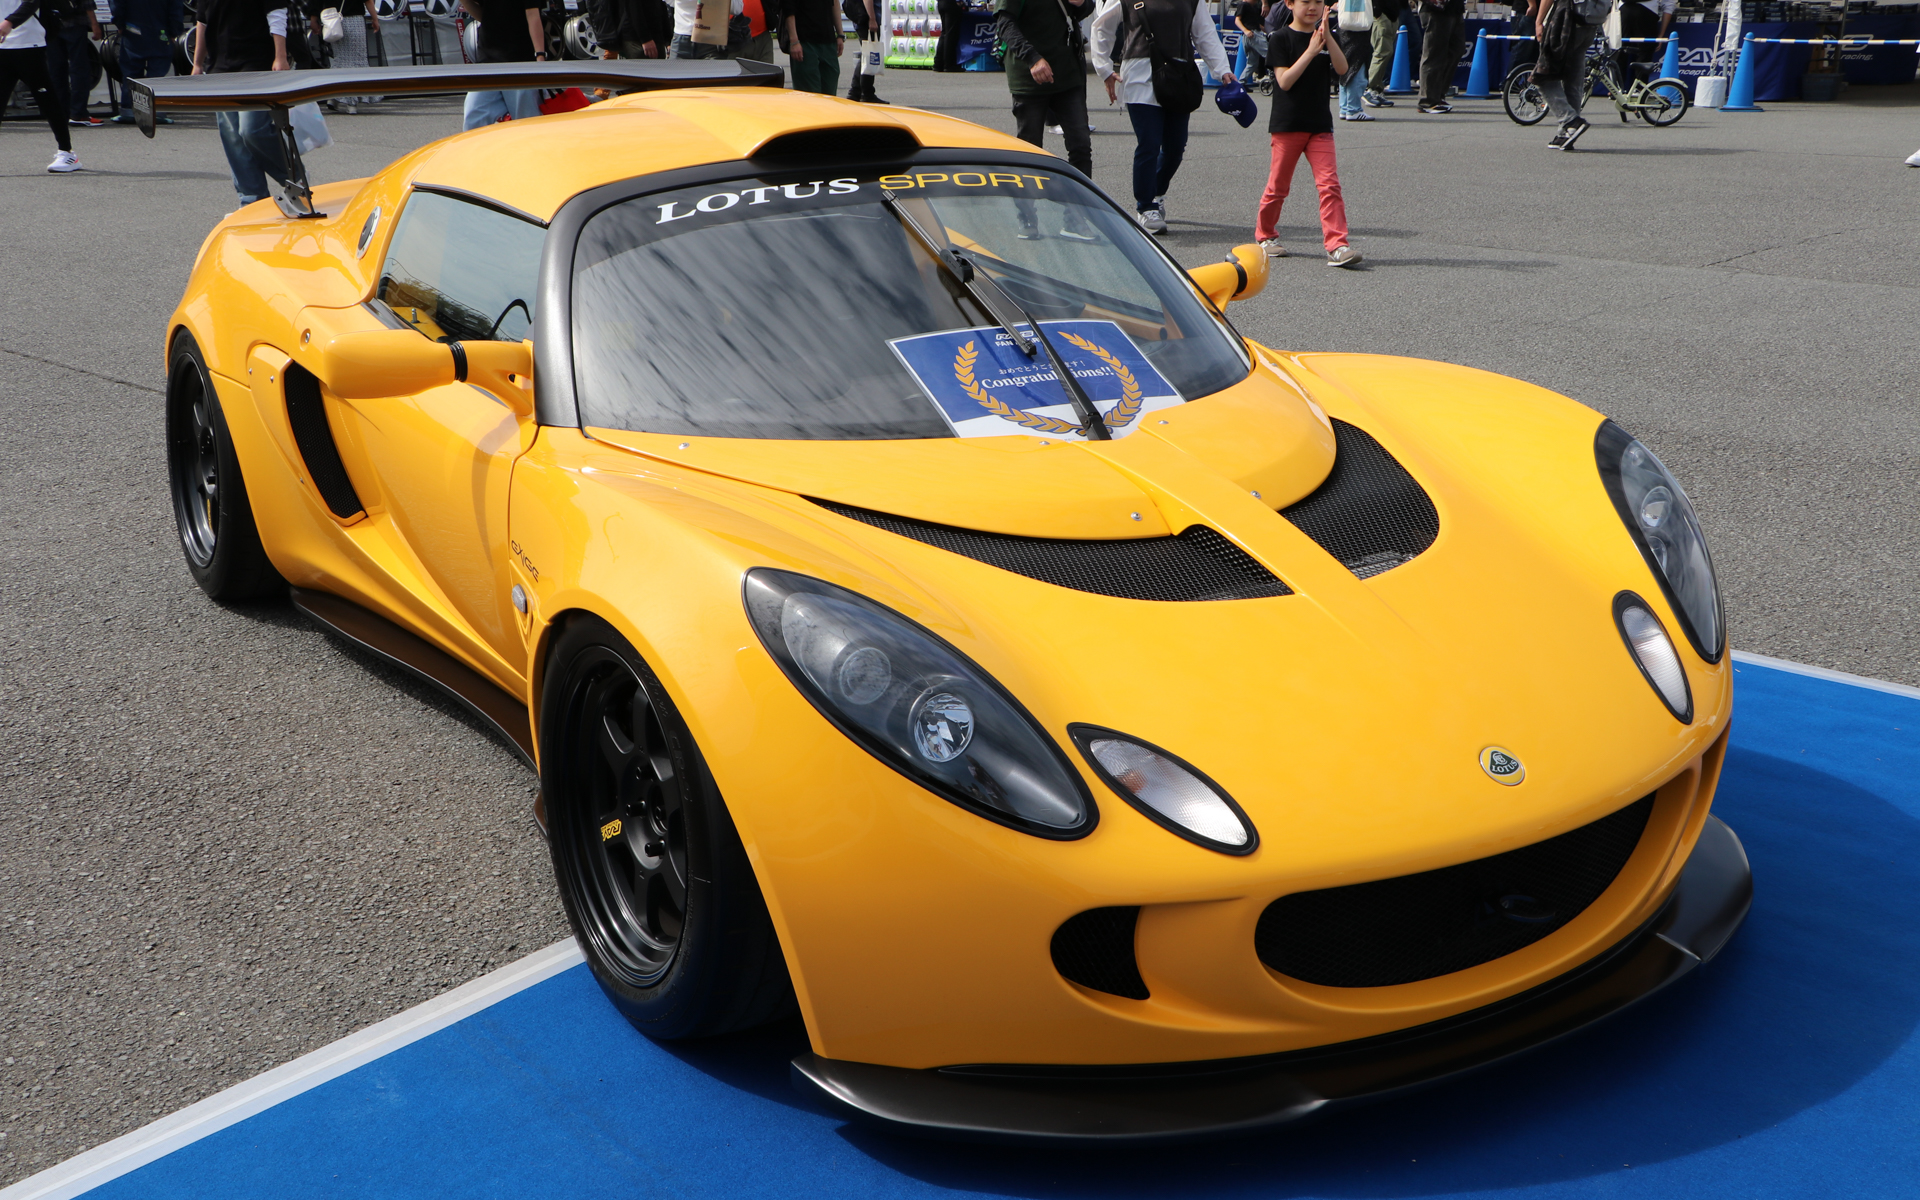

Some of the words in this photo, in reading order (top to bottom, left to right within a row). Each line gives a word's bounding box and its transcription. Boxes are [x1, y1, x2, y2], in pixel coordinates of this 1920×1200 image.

[656, 178, 860, 225] LOTUS
[879, 172, 1051, 190] SPORT
[996, 330, 1034, 340] RAS
[981, 366, 1115, 389] Congratulions!!
[1492, 760, 1517, 773] LOTUS
